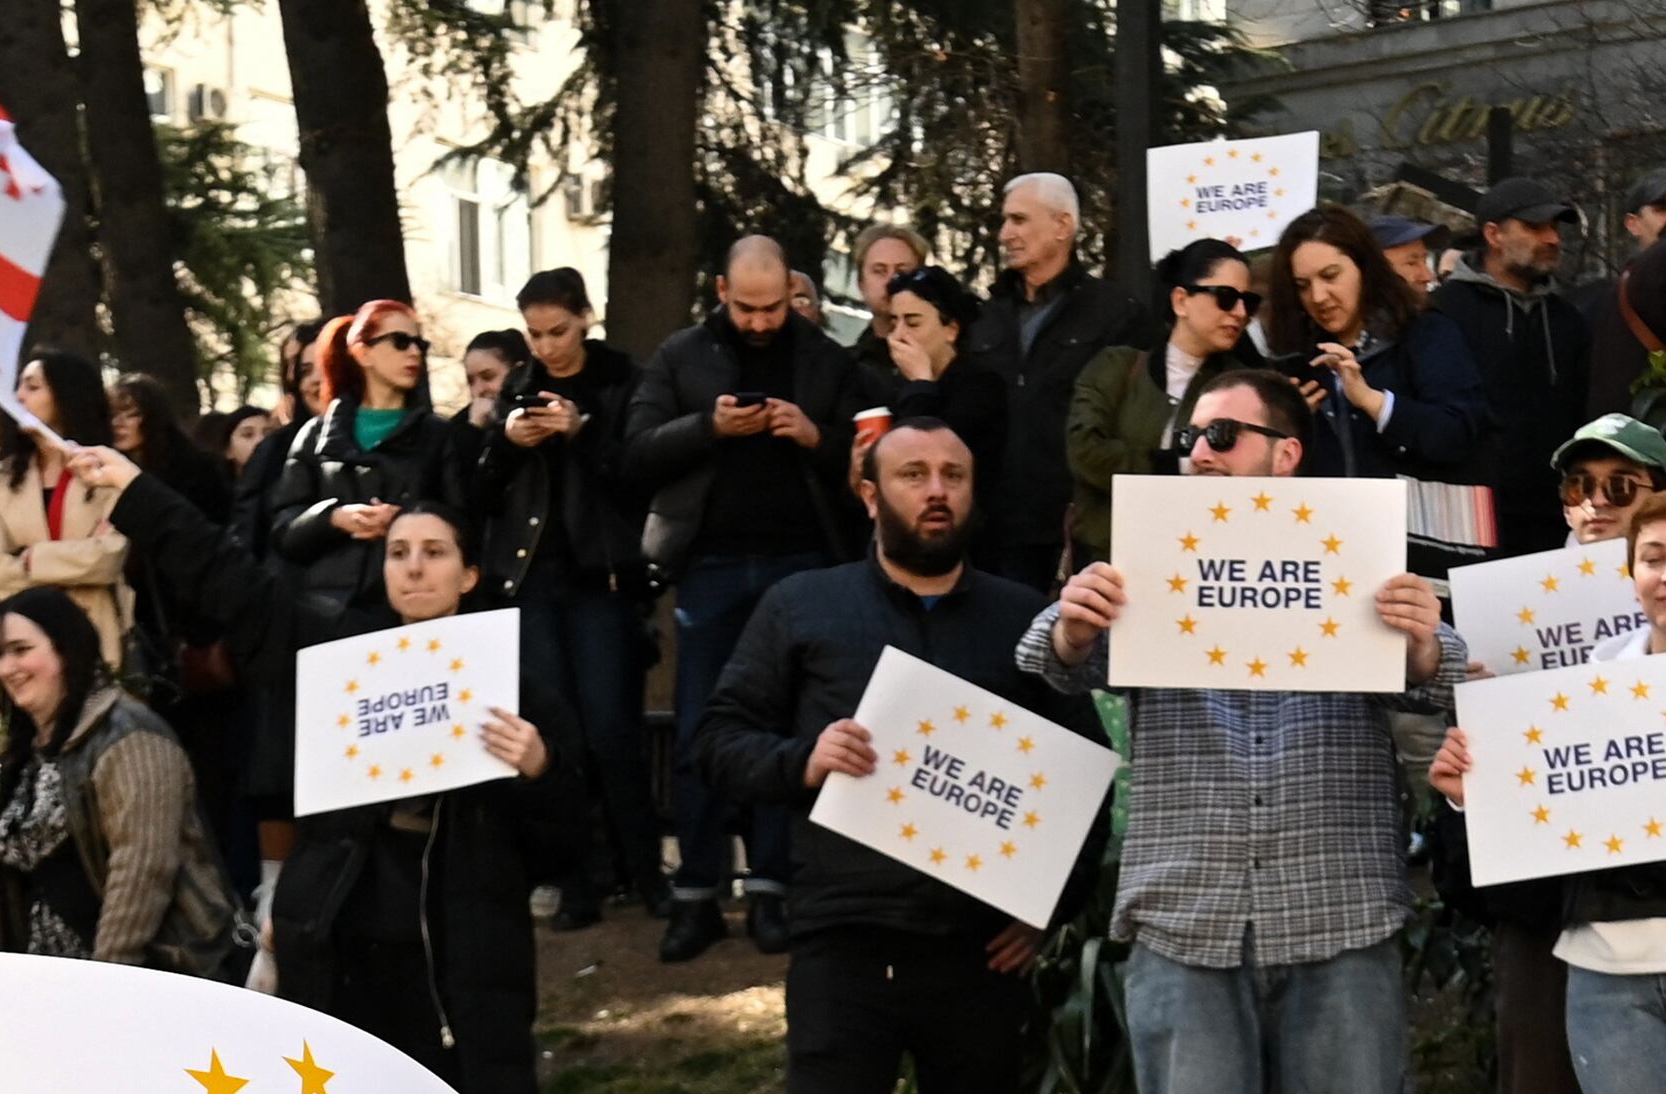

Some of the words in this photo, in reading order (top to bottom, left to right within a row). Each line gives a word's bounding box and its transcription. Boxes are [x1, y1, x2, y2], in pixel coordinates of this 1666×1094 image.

[1196, 184, 1224, 199] WE
[1231, 181, 1267, 196] ARE
[1196, 195, 1267, 214] EUROPE
[1198, 559, 1246, 582] WE
[1257, 559, 1321, 584] ARE
[1197, 585, 1322, 609] EUROPE
[1535, 622, 1585, 649] WE
[357, 681, 449, 717] EUROPE
[358, 712, 405, 738] ARE
[414, 703, 450, 727] WE
[1543, 743, 1593, 770] WE
[1603, 732, 1666, 762] ARE
[923, 744, 966, 781] WE
[967, 770, 1024, 809] ARE
[910, 767, 1015, 830] EUROPE
